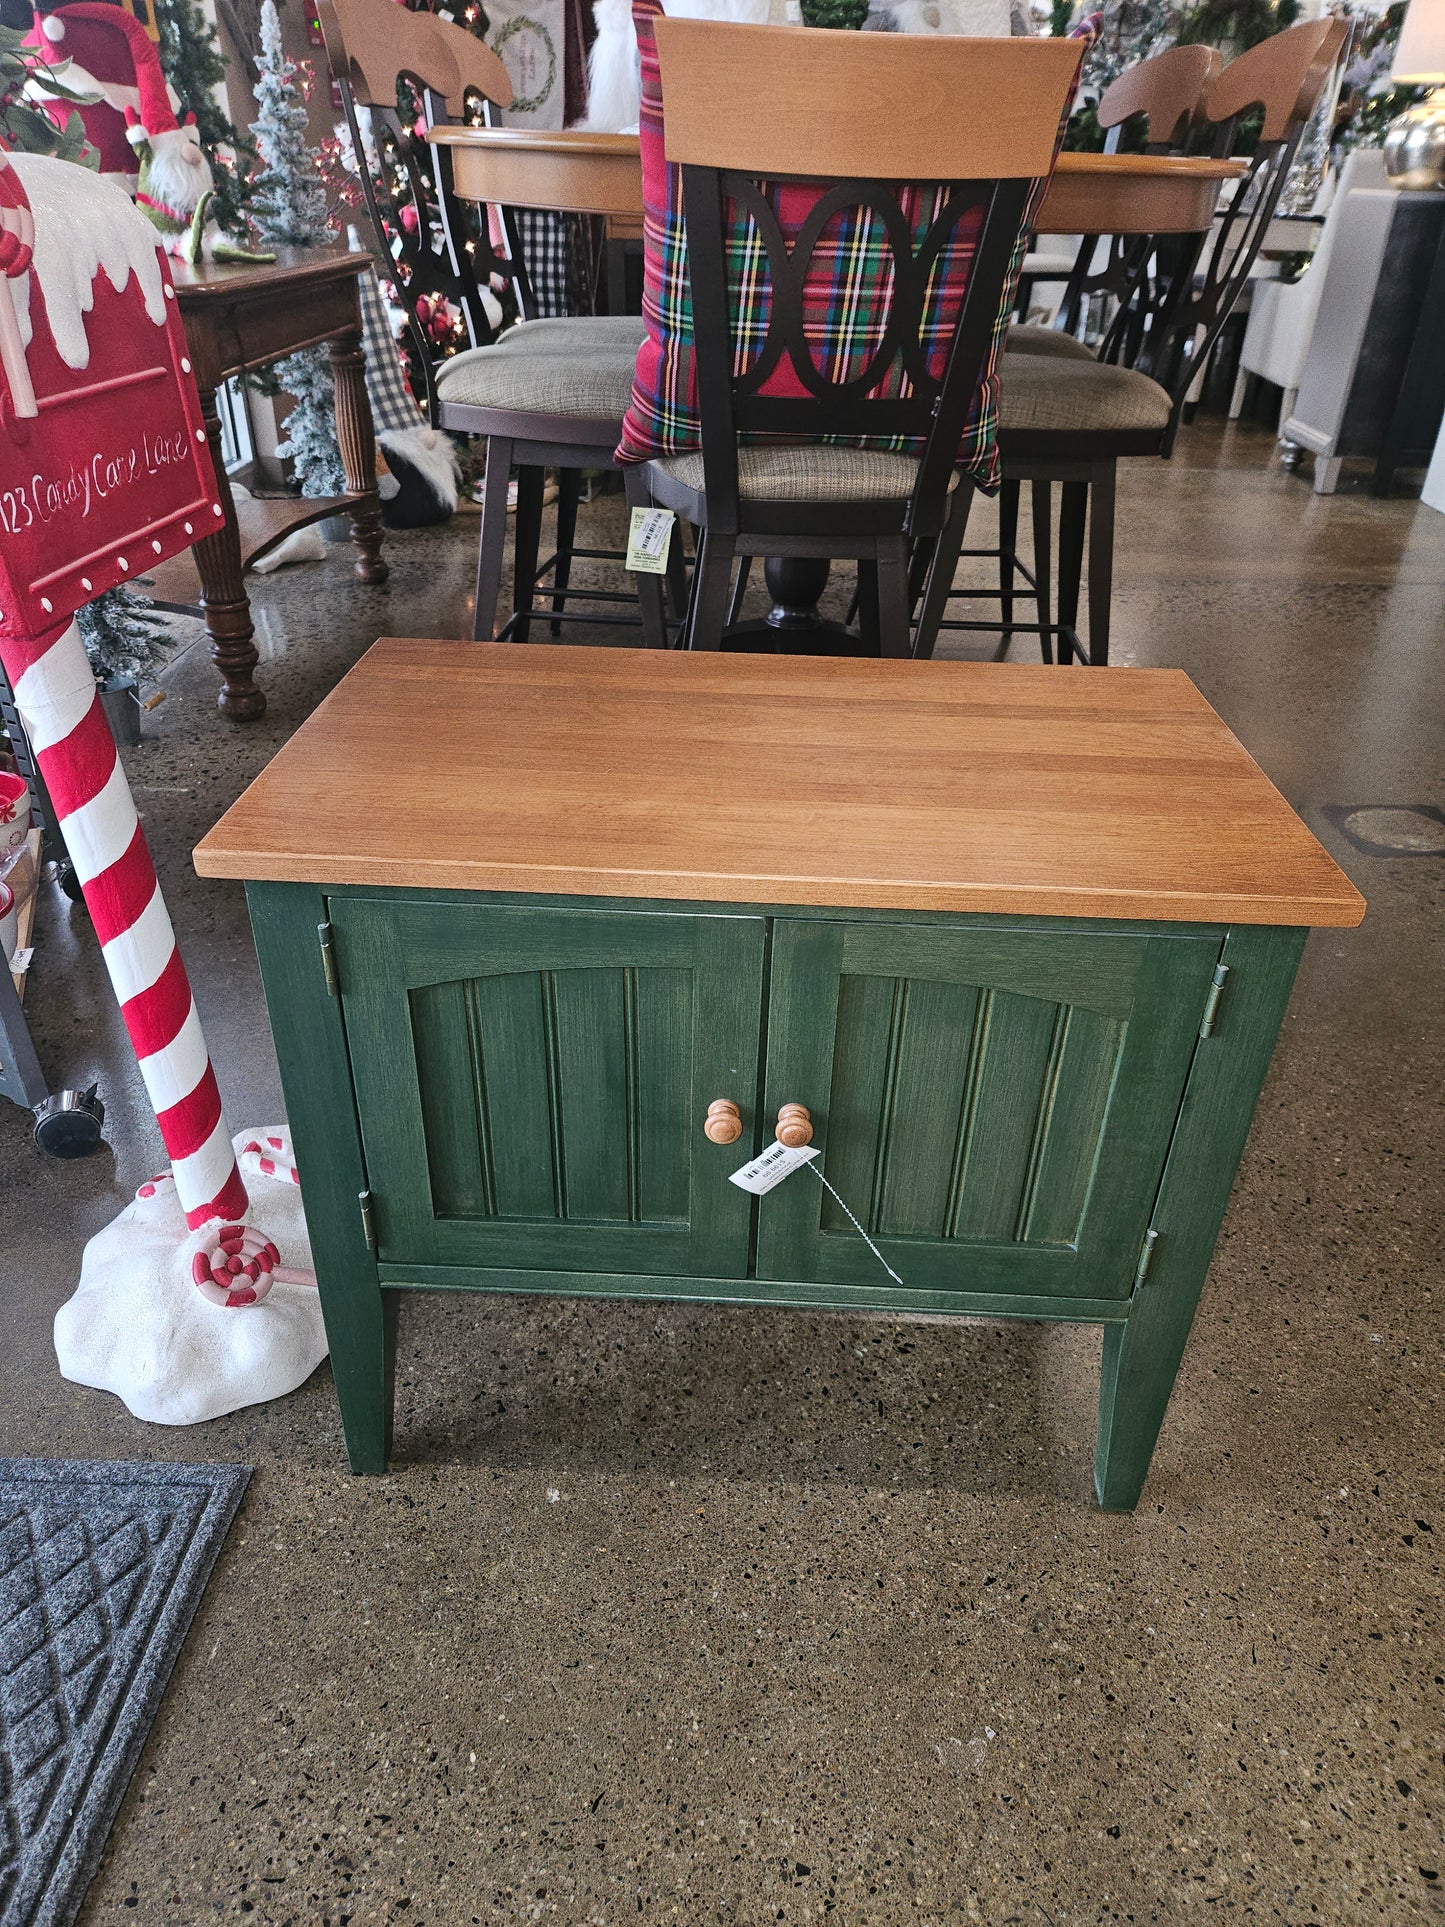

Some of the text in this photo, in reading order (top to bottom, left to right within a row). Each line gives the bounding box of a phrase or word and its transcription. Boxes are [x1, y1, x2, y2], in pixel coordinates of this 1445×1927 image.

[0, 431, 188, 533] 123 Candy Cane Lane
